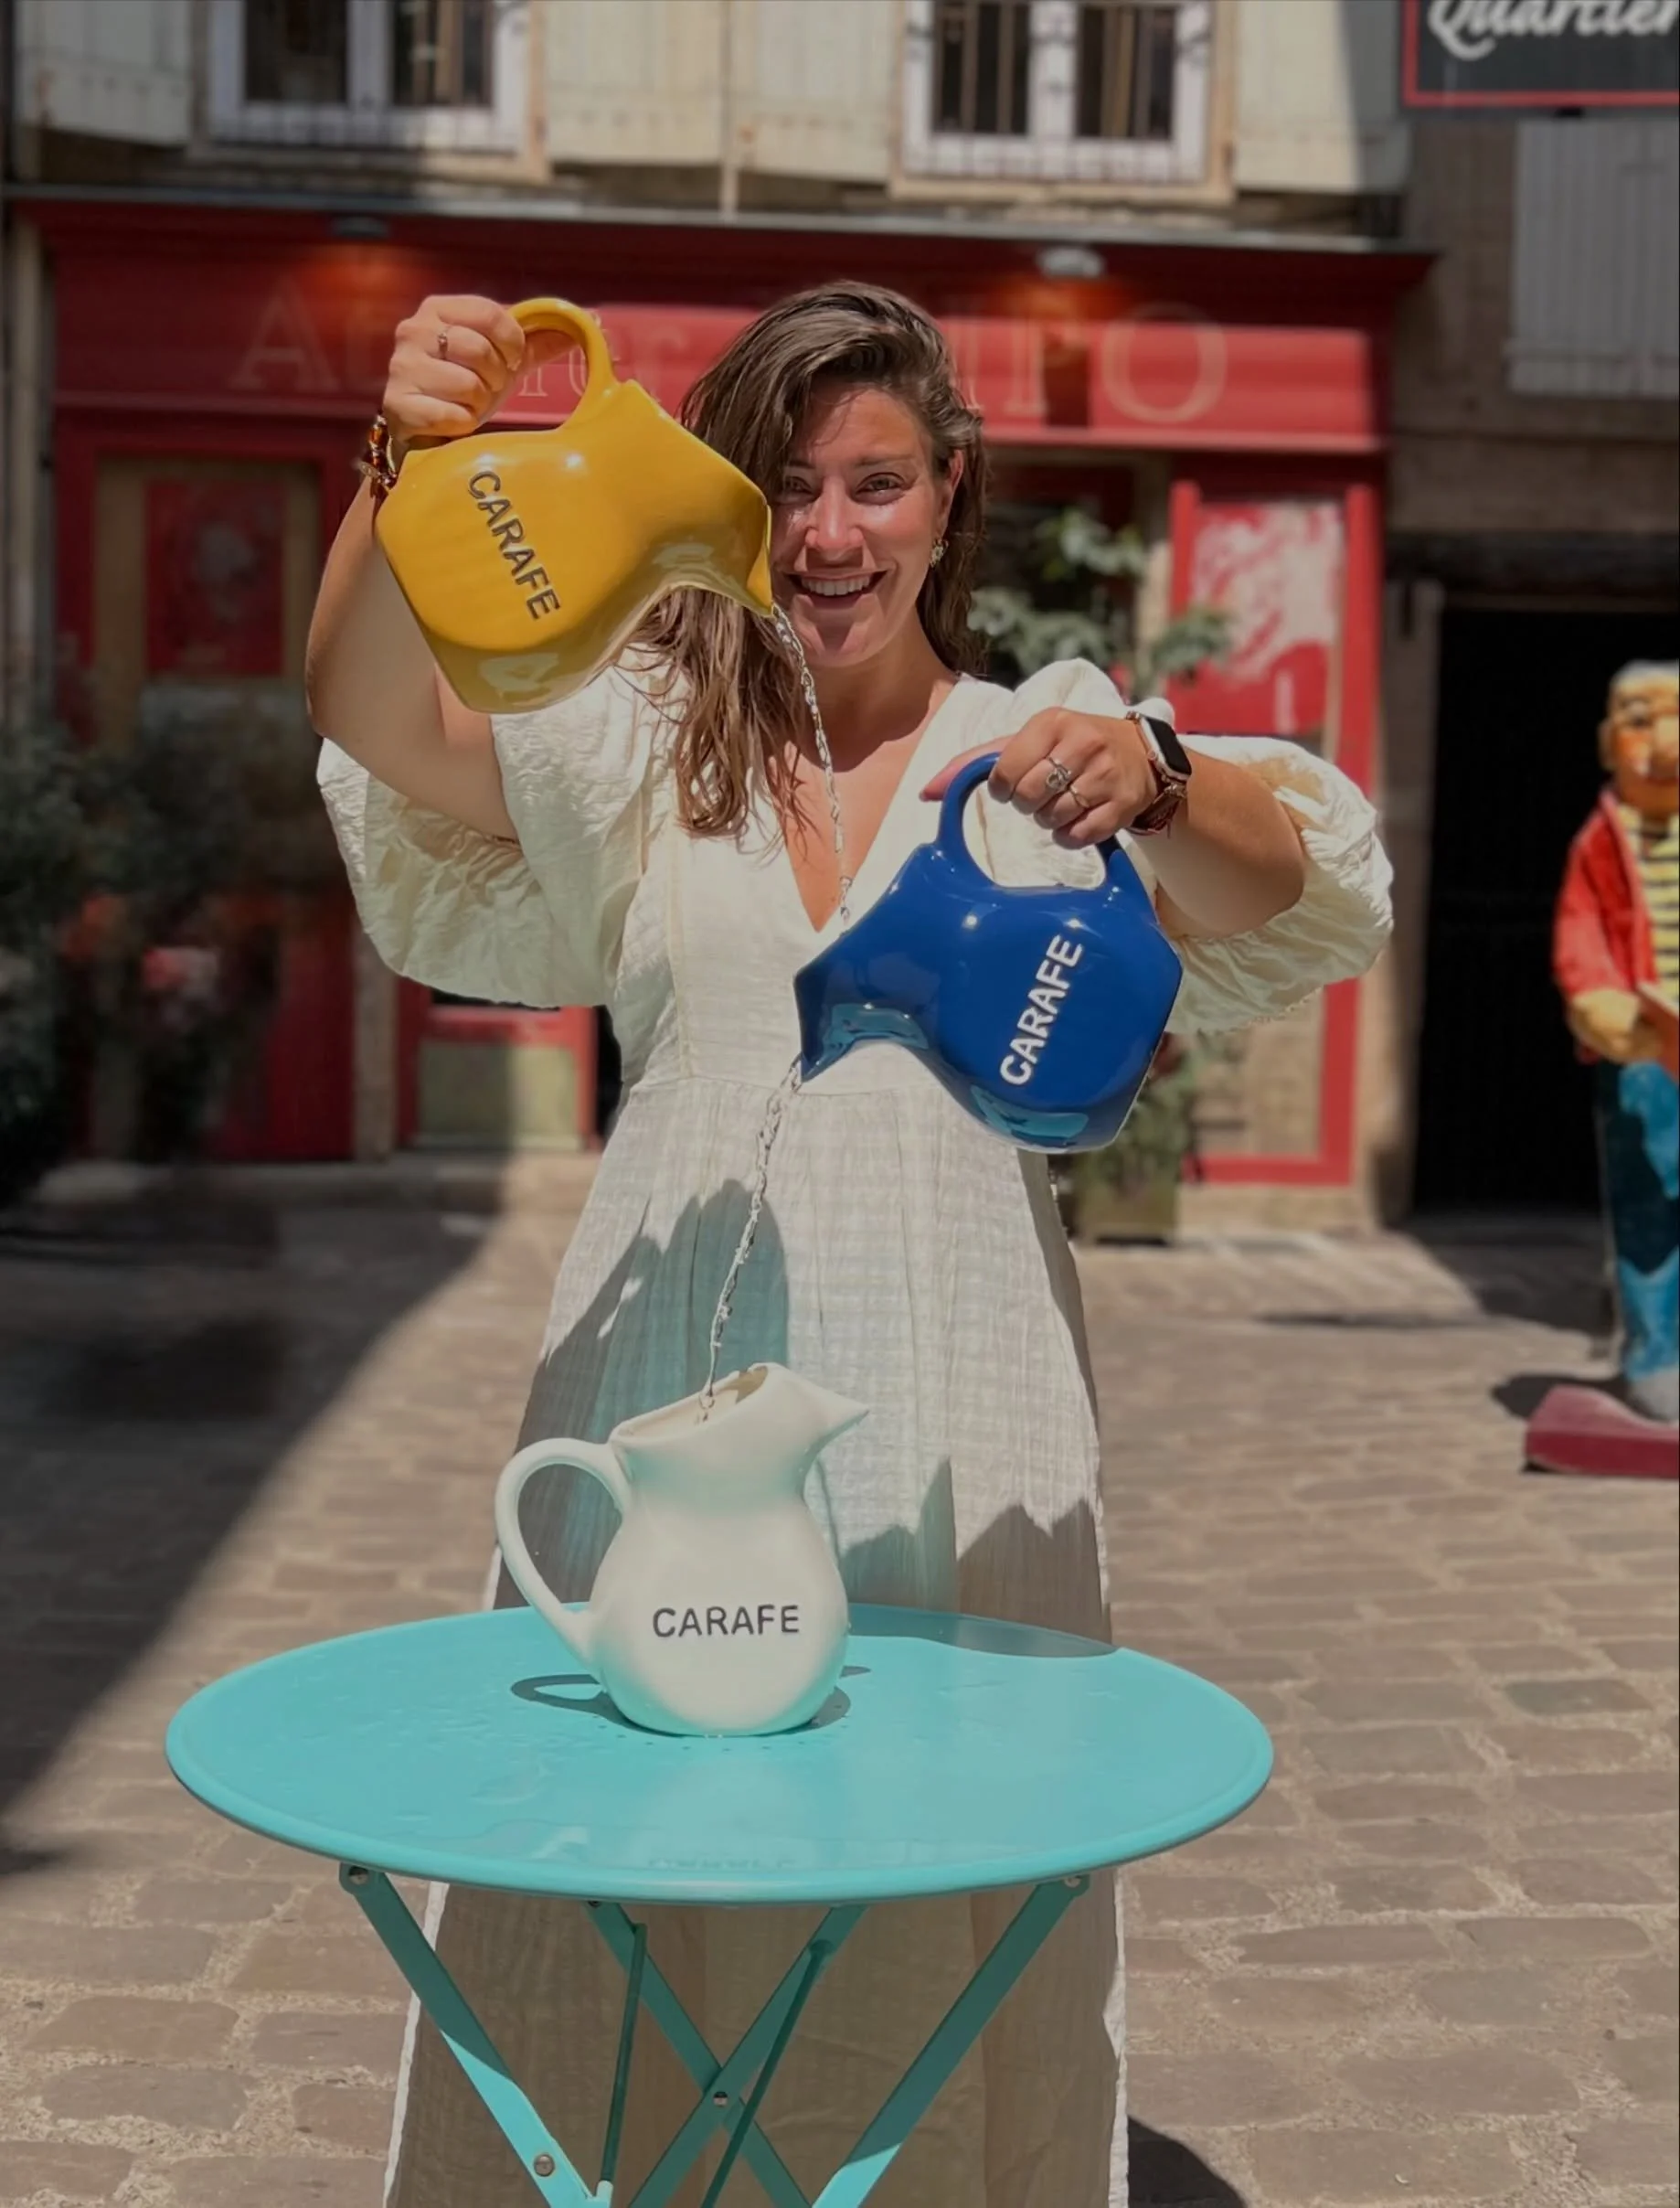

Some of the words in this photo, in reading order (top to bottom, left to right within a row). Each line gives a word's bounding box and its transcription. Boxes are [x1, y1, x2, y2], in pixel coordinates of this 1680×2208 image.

[468, 471, 560, 621] CARAFE
[1000, 934, 1083, 1085] CARAFE
[653, 1605, 799, 1637] CARAFE
